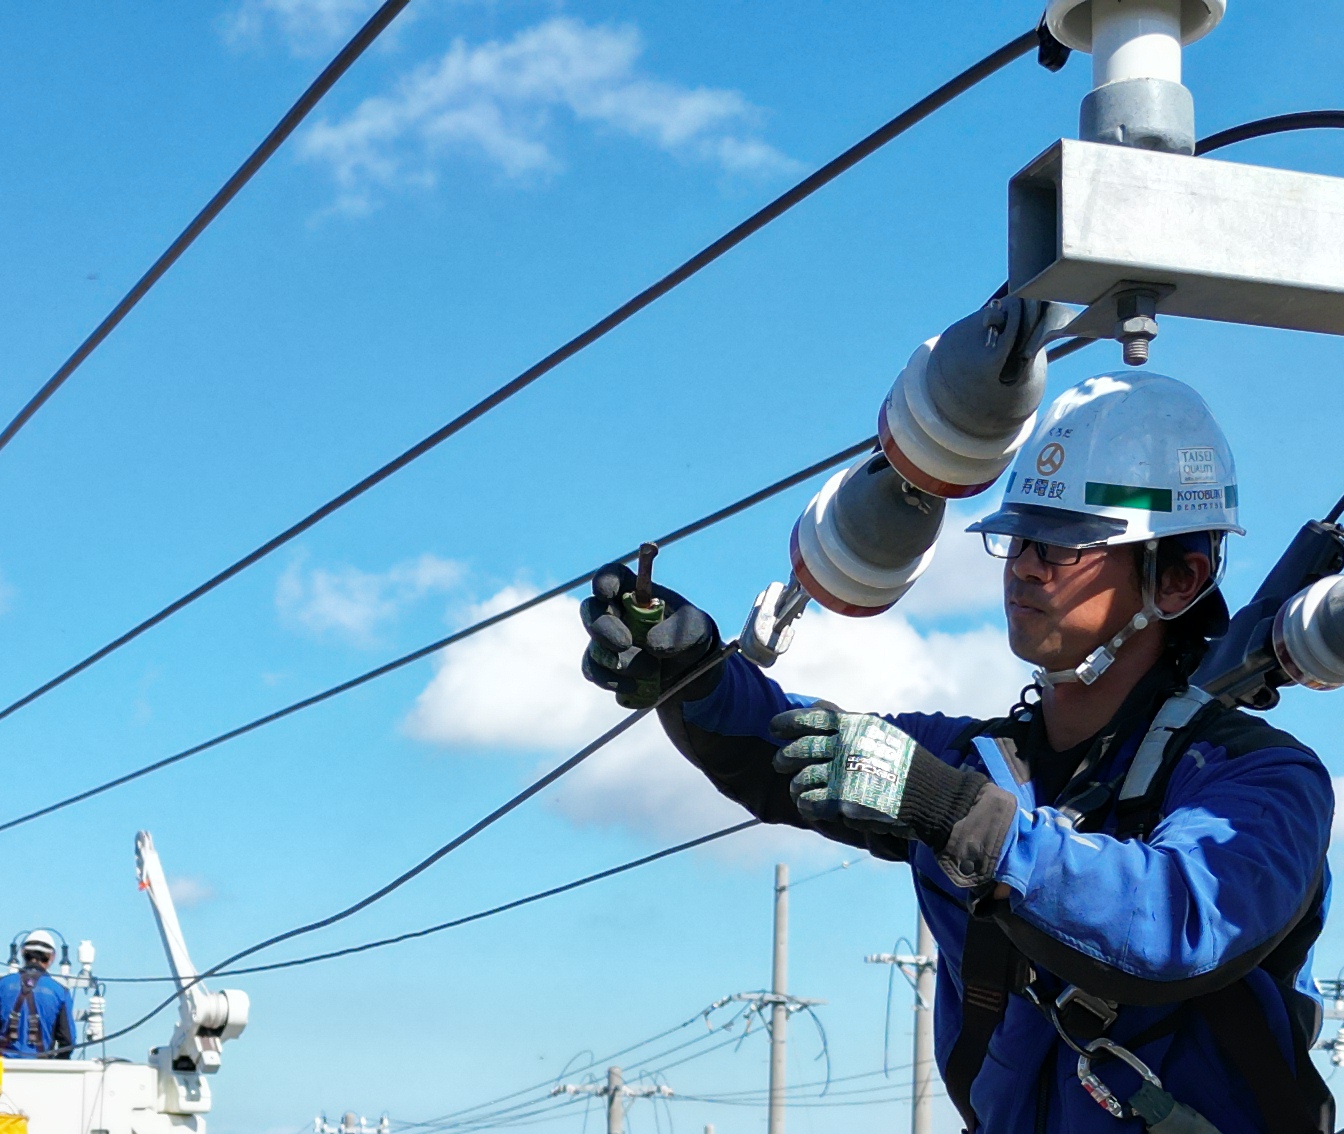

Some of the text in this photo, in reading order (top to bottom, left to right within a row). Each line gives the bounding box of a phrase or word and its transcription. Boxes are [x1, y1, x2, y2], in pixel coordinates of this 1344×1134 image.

[1049, 427, 1073, 438] くろだ
[1182, 451, 1212, 462] TAISEI
[1022, 477, 1066, 500] 寿電設
[1177, 489, 1223, 501] KOTOBUKI
